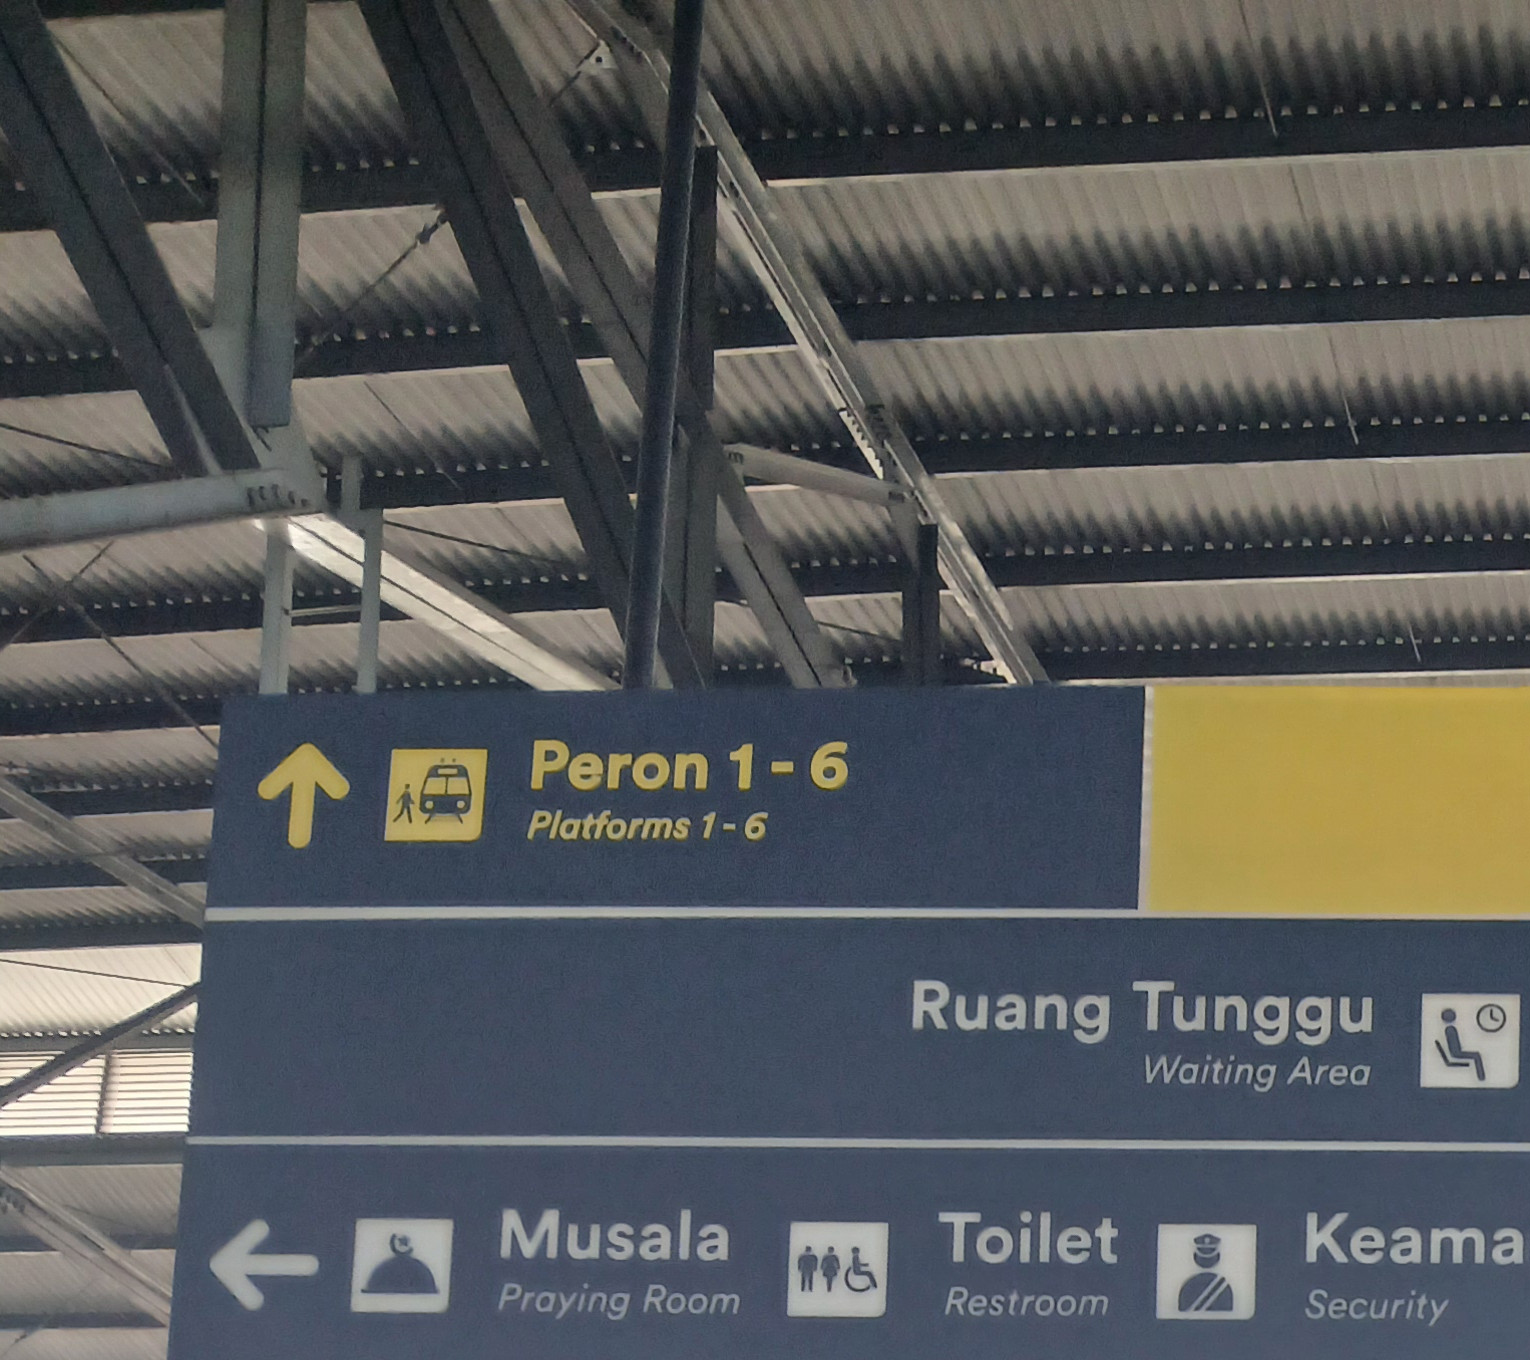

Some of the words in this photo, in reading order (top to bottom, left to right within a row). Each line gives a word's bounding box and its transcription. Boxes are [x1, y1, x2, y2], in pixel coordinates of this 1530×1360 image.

[530, 739, 709, 791] Peron
[729, 743, 754, 791] 1
[770, 760, 795, 774] -
[809, 741, 849, 790] 6
[526, 809, 692, 840] Platforms
[702, 811, 717, 839] 1
[743, 811, 769, 841] 6
[912, 979, 1110, 1045] Ruang
[1132, 980, 1373, 1046] Tunggu
[1145, 1054, 1277, 1093] Waiting
[1286, 1056, 1371, 1086] Area
[500, 1208, 729, 1262] Musala
[938, 1211, 1119, 1265] Toilet
[498, 1282, 631, 1321] Praying
[643, 1284, 741, 1315] Room
[944, 1286, 1109, 1317] Restroom
[1304, 1288, 1449, 1327] Security
